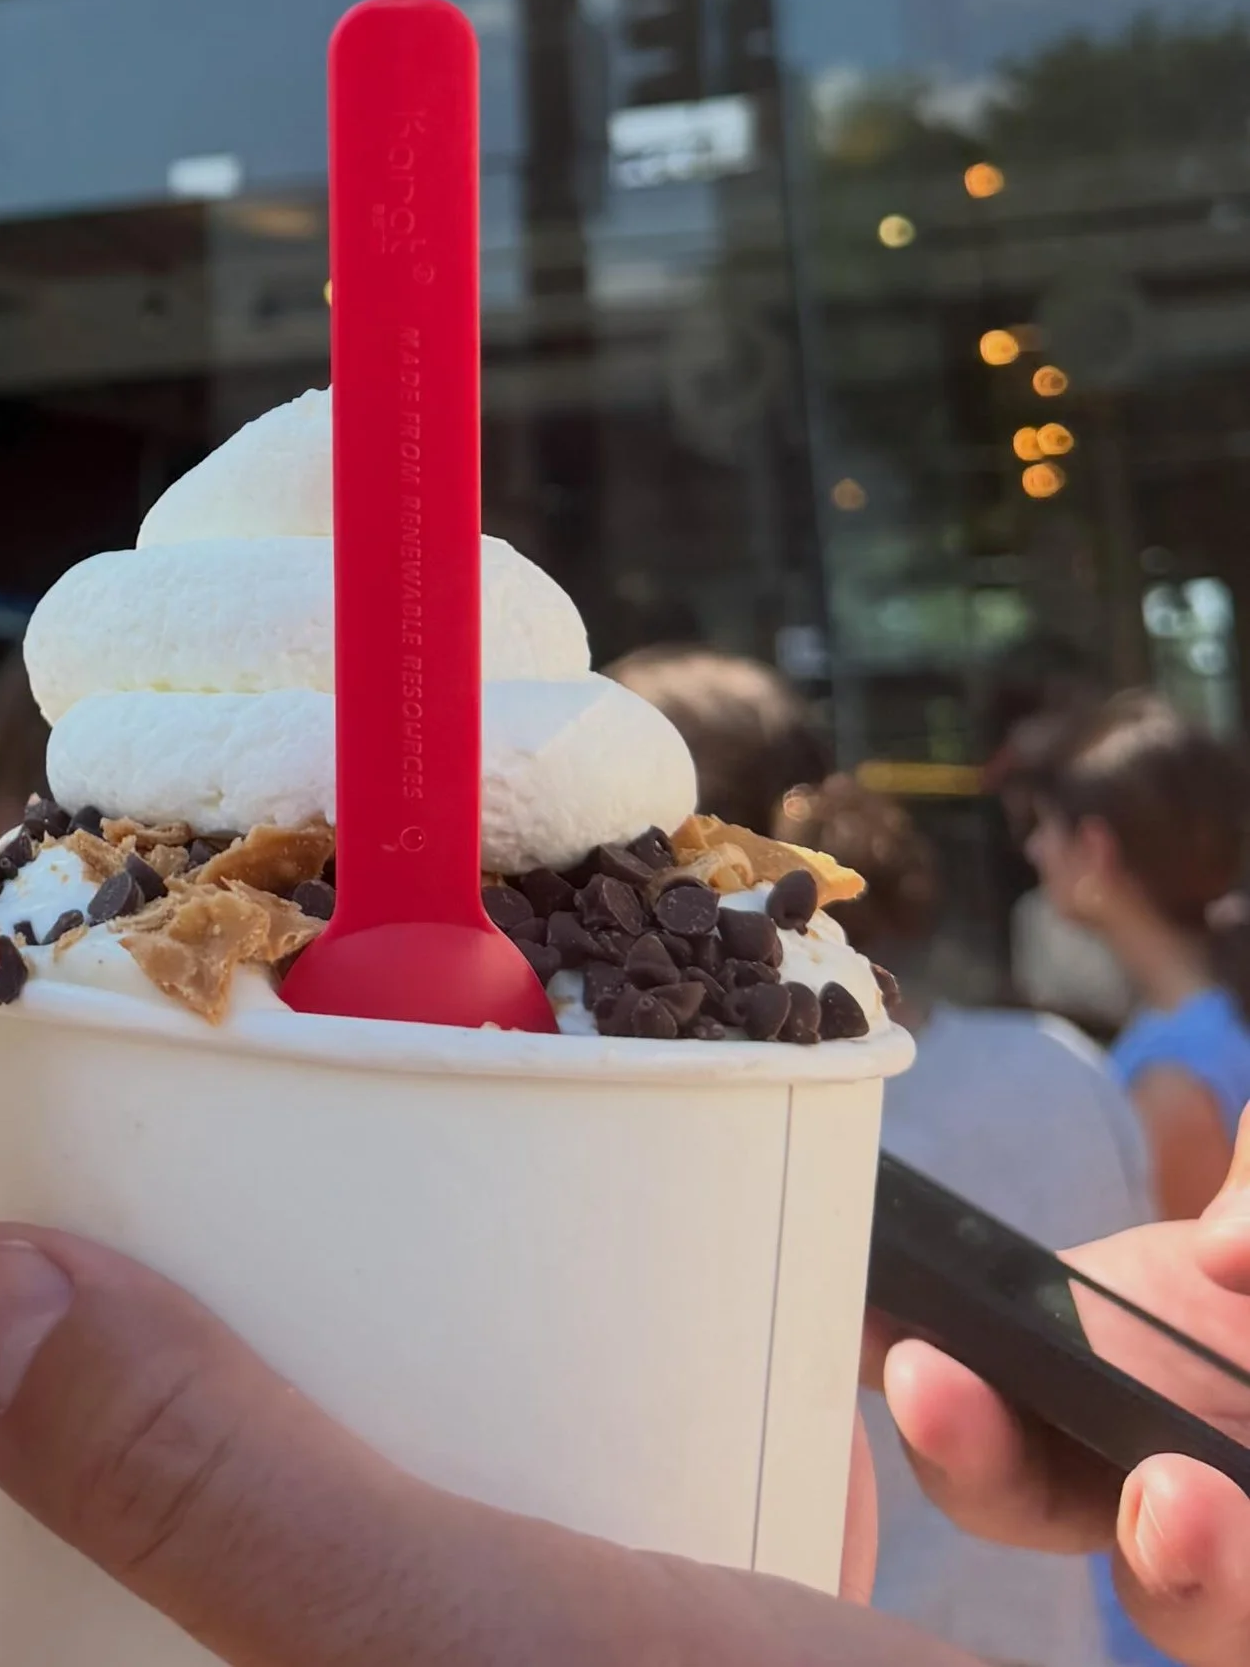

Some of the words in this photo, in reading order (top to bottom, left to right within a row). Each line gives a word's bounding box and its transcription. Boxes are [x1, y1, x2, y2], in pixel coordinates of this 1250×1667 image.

[397, 324, 421, 403] MADE
[398, 409, 421, 485] FROM
[398, 494, 424, 646] RENEWABLE
[400, 654, 423, 800] RESOURCES
